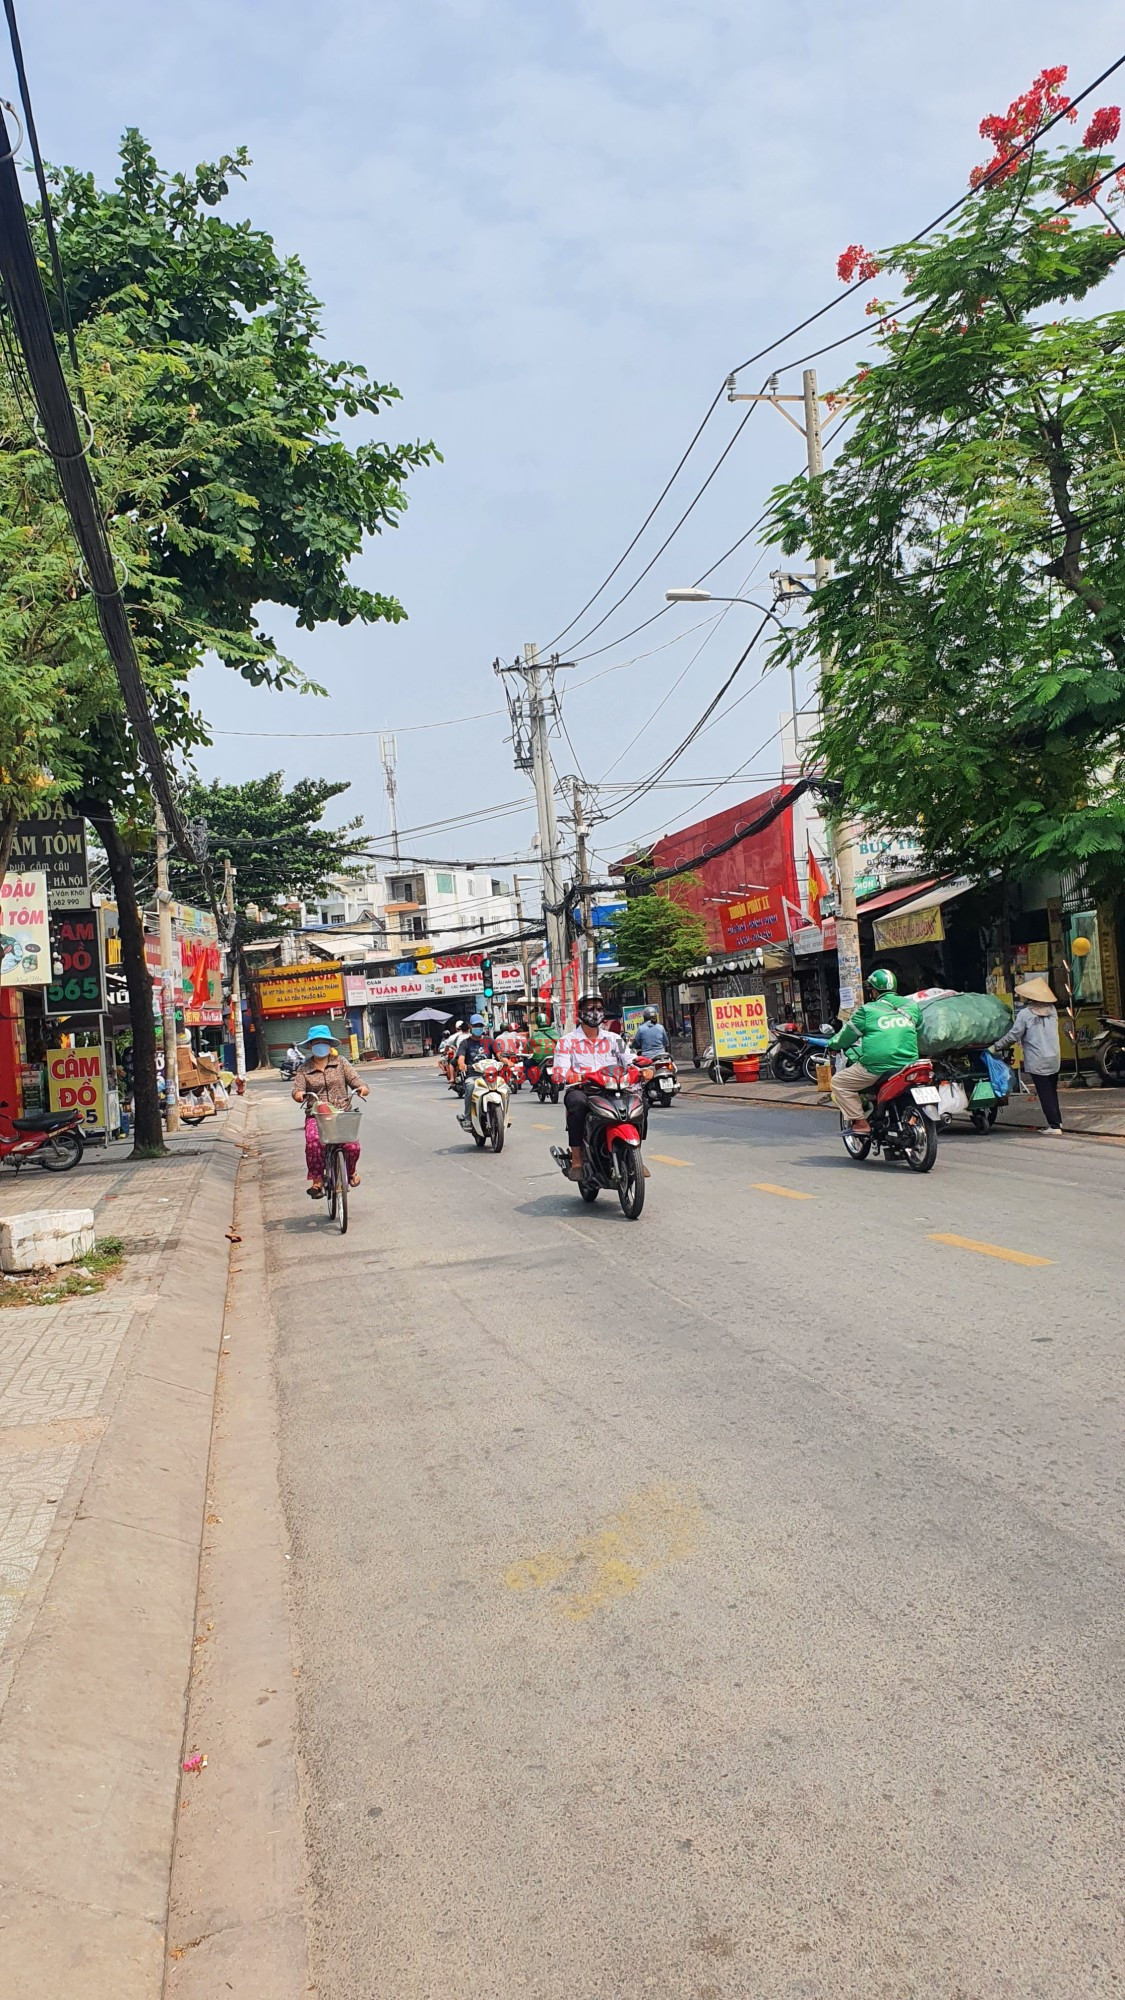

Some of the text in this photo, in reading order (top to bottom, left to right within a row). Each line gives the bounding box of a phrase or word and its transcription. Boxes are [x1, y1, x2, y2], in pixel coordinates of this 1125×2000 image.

[41, 830, 83, 855] TÔM
[1, 879, 36, 902] ĐẬU
[53, 875, 67, 887] HÀ
[68, 874, 83, 888] NỘI
[9, 906, 44, 926] TÔM
[48, 977, 99, 1003] 565
[715, 999, 763, 1020] BÚN BÒ
[51, 1050, 100, 1080] CẦM
[59, 1077, 97, 1108] ĐỒ
